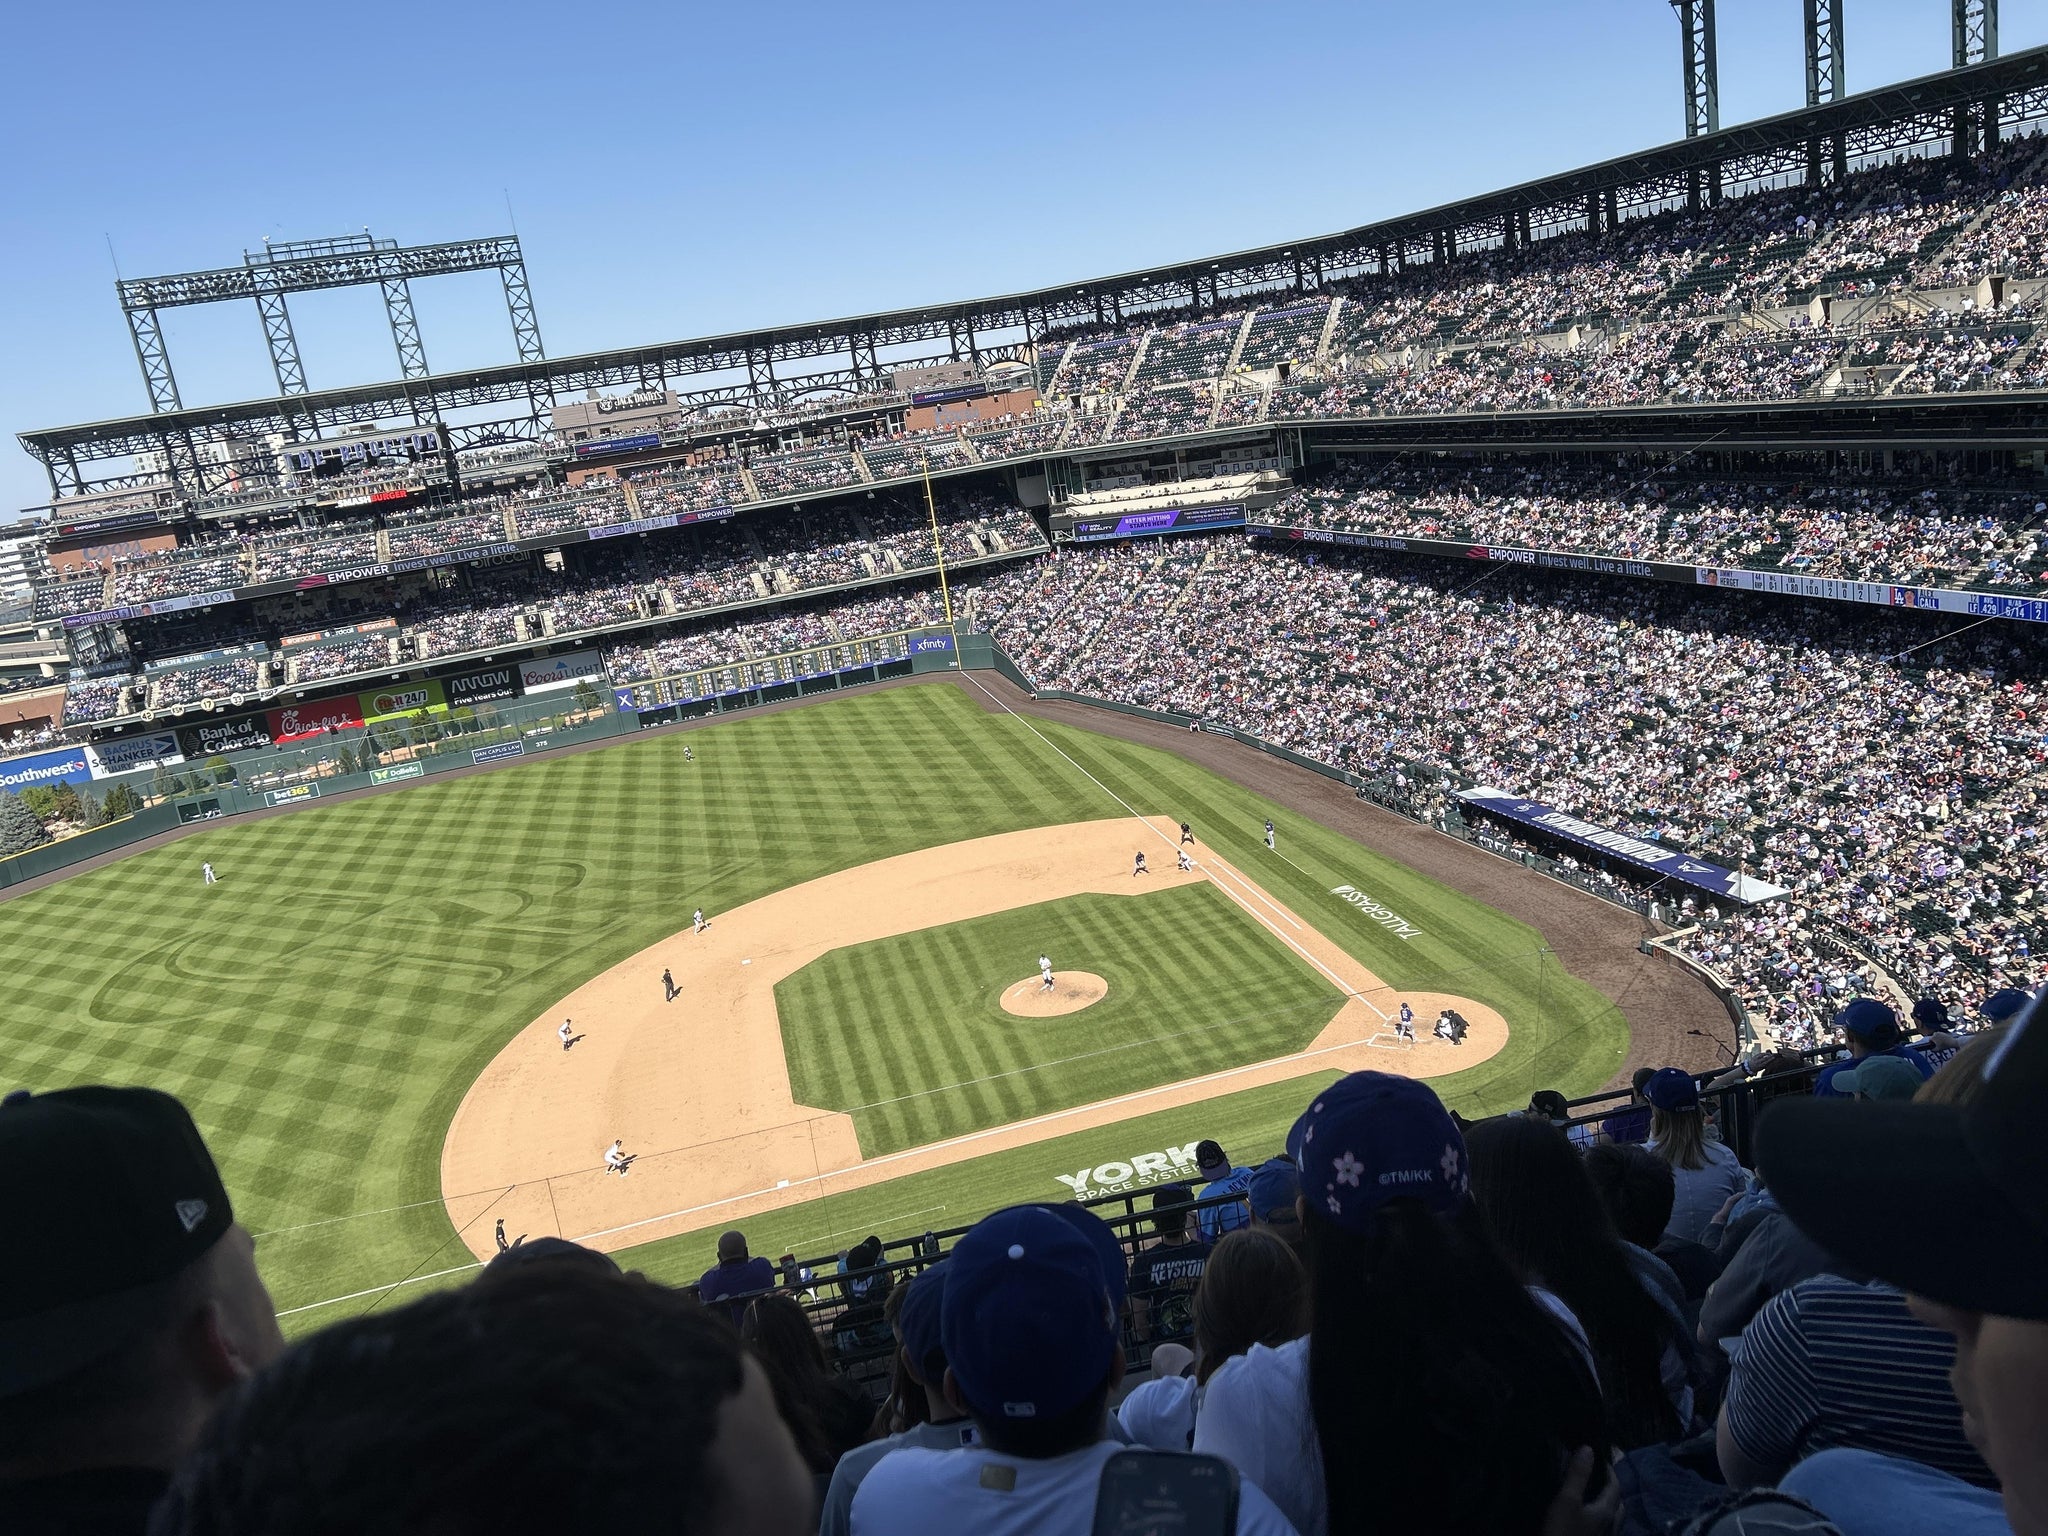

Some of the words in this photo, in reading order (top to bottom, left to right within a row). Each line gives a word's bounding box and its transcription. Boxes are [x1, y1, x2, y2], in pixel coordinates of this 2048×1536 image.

[615, 397, 633, 407] JACK
[634, 391, 663, 403] DANIEL'S
[770, 416, 801, 429] Silver
[282, 449, 325, 469] THE
[339, 432, 436, 463] ROOFTOP
[589, 443, 612, 451] EMPOWER
[337, 489, 408, 508] SMASHBURGER
[697, 507, 732, 520] EMPOWER
[1124, 516, 1148, 524] BETTER
[1148, 514, 1171, 523] HITTING
[74, 523, 101, 531] EMPOWER
[1303, 530, 1334, 543] EMPOWER
[1335, 534, 1354, 544] Invest
[1354, 535, 1370, 546] well.
[1370, 537, 1384, 548] Live
[1390, 539, 1409, 550] little.
[327, 565, 390, 583] EMPOWER
[393, 557, 428, 571] Invest
[429, 554, 456, 567] well.
[457, 549, 477, 563] Live
[477, 549, 489, 559] a
[490, 543, 520, 557] little.
[1489, 548, 1535, 564] EMPOWER
[1538, 553, 1568, 568] Invest
[1569, 557, 1592, 570] well.
[1594, 559, 1615, 573] Live
[1617, 564, 1623, 573] a
[1625, 562, 1654, 577] little.
[1719, 577, 1740, 588] HERGET
[1769, 581, 1777, 591] 0-1
[1785, 582, 1799, 593] 1.80
[1805, 584, 1819, 596] 10.0
[1828, 587, 1833, 597] 2
[1842, 589, 1847, 599] 0
[1858, 591, 1863, 600] 2
[1876, 592, 1881, 602] 7
[1894, 588, 1904, 605] LA
[1919, 597, 1937, 609] CALL
[1969, 604, 1978, 613] LF
[1980, 604, 1997, 615] .429
[2005, 606, 2025, 618] 6/14
[2035, 610, 2041, 620] 2
[2034, 602, 2043, 610] 2B
[80, 611, 119, 626] STRIKEOUTS
[528, 614, 536, 623] O
[917, 638, 947, 651] xfinity
[181, 654, 206, 664] AZUL
[273, 661, 281, 670] O
[451, 670, 510, 694] ARROW
[523, 669, 565, 687] Coors
[564, 663, 600, 678] LIGHT
[136, 686, 144, 695] C
[404, 689, 427, 705] 24/7
[453, 695, 472, 706] Five
[472, 691, 497, 703] Years
[496, 686, 515, 698] Out
[202, 700, 213, 710] 17
[233, 695, 243, 704] 33
[617, 694, 633, 707] X
[140, 711, 153, 720] 42
[199, 723, 237, 741] Bank
[238, 718, 253, 734] of
[281, 711, 353, 737] Chick-fil-A
[104, 738, 154, 756] BACHUS
[203, 731, 271, 754] Colorado
[487, 746, 508, 756] CAPLIS
[508, 743, 520, 753] LAW
[535, 740, 548, 748] 375
[91, 749, 155, 768] SCHANKER
[0, 761, 76, 787] Southwest
[101, 762, 134, 775] INJURY
[273, 785, 310, 800] bet365
[1341, 891, 1423, 940] TALLGRASS
[1054, 1140, 1199, 1194] YORK
[1075, 1181, 1134, 1202] SPACE
